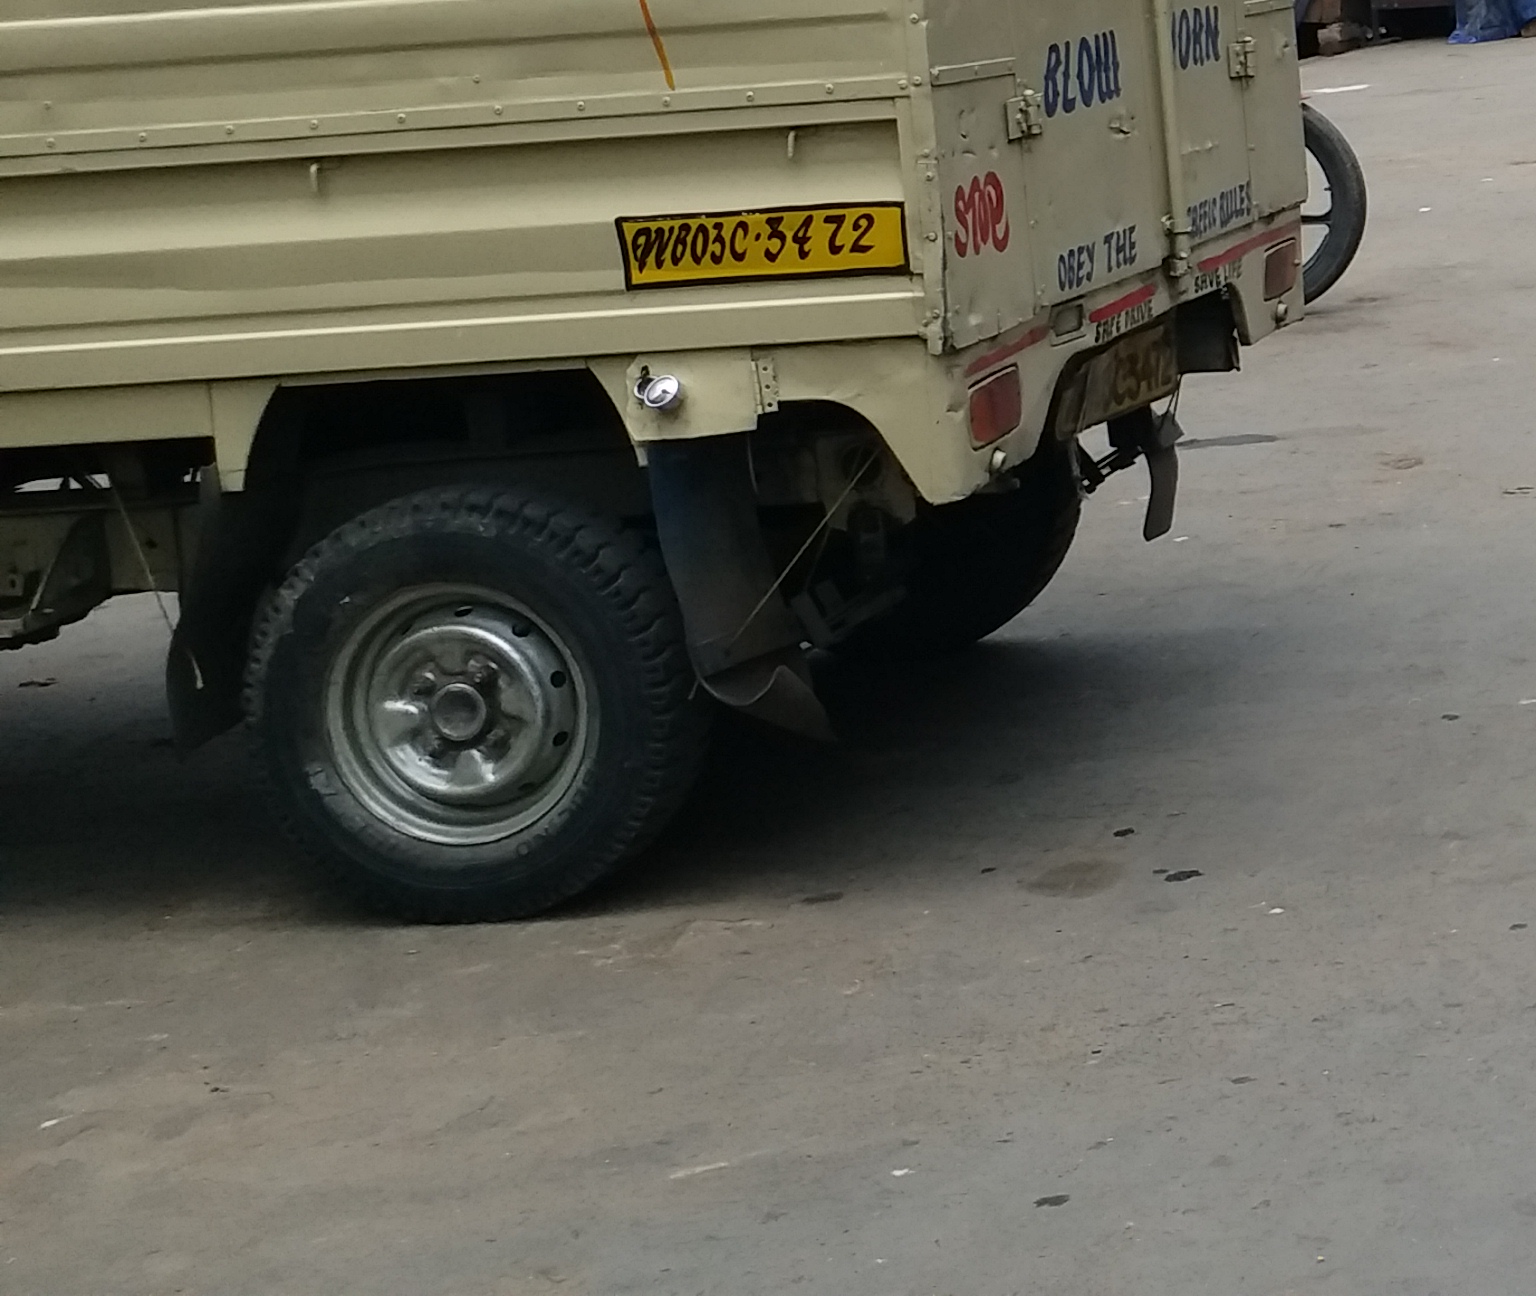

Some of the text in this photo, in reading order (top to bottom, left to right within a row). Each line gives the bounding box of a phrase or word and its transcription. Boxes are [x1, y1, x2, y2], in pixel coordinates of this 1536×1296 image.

[1043, 29, 1122, 119] BLOW
[954, 170, 1010, 258] STOP
[1057, 224, 1137, 292] OBEY THE
[1194, 268, 1222, 294] SAVE
[1095, 310, 1122, 344] SAFE
